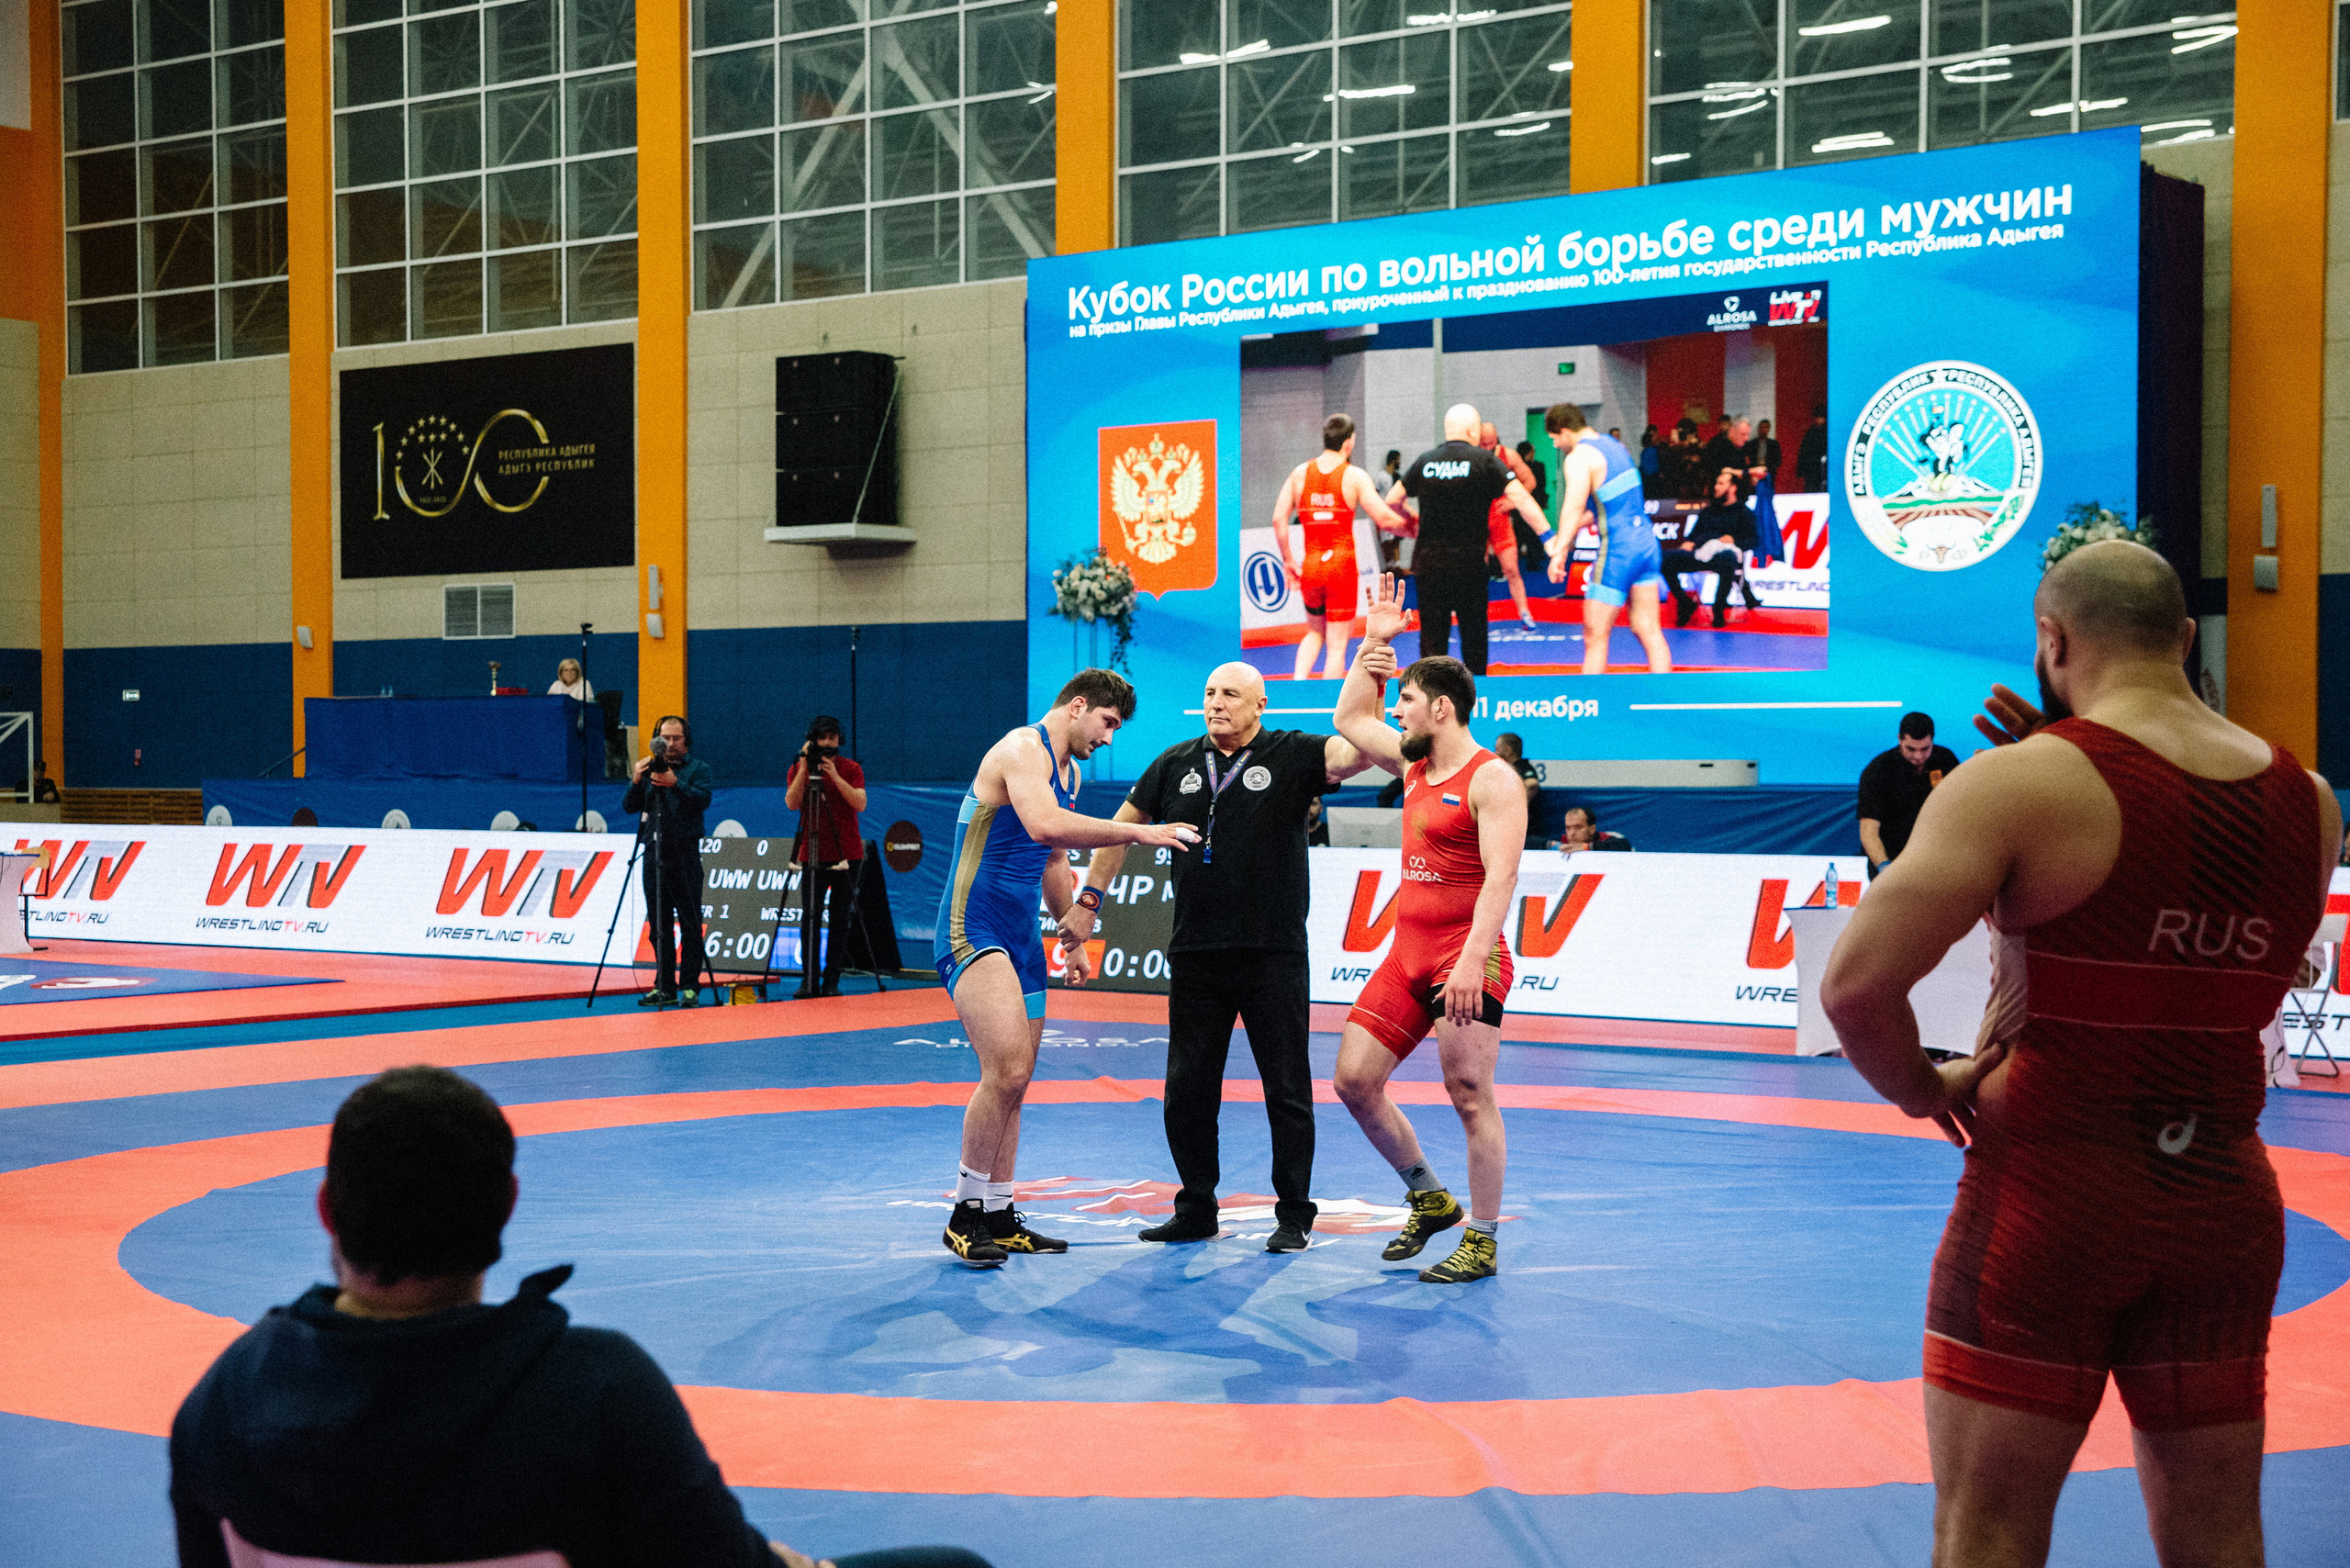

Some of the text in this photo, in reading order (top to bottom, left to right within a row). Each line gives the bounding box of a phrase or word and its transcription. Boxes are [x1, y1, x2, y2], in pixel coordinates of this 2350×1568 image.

[1069, 184, 2072, 323] Кубок России по вольной борьбе среди мужчин
[1069, 224, 2064, 338] на призы Главы Республики Адыгея, приуроченный к празднованию 100-летия государственности Республика Адыгея
[1707, 310, 1757, 326] ALROSA
[498, 443, 596, 460] РЕСПУБЛИКА АДЫГЕЯ
[535, 458, 596, 473] РЕСПУБЛИК
[1423, 461, 1471, 479] СУДЬЯ
[1310, 493, 1336, 507] RUS
[1494, 695, 1599, 722] декабря
[756, 839, 768, 857] 0
[206, 843, 367, 908] WTV
[436, 847, 615, 918] WTV
[708, 868, 754, 890] UWW
[1107, 875, 1154, 904] ЧР
[196, 917, 329, 933] WRESTLINGTV.RU
[426, 926, 575, 945] WRESTLINGTV.RU
[2148, 909, 2273, 960] RUS
[705, 931, 770, 960] 6:00
